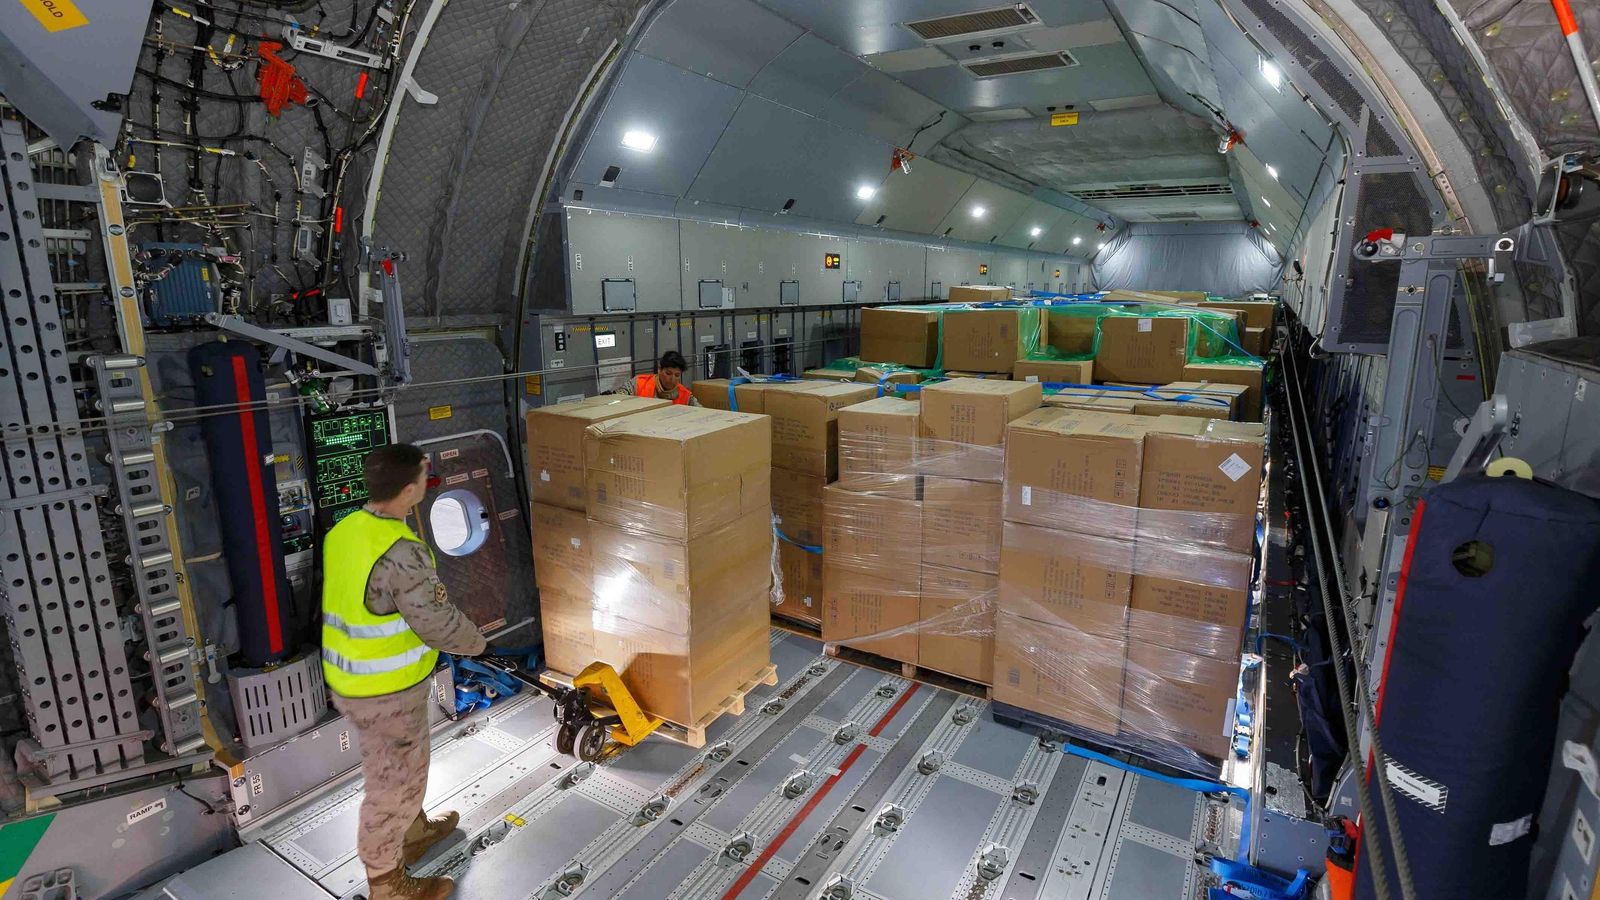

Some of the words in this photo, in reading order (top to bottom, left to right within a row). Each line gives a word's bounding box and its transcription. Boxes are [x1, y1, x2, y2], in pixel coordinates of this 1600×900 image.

[41, 0, 64, 18] OLD
[598, 337, 611, 346] EXIT
[442, 450, 457, 458] OPEN
[439, 692, 445, 702] FR
[340, 732, 347, 741] 54
[341, 740, 348, 751] FR
[252, 774, 261, 784] 55
[253, 783, 262, 795] FR
[130, 805, 152, 820] RAMP
